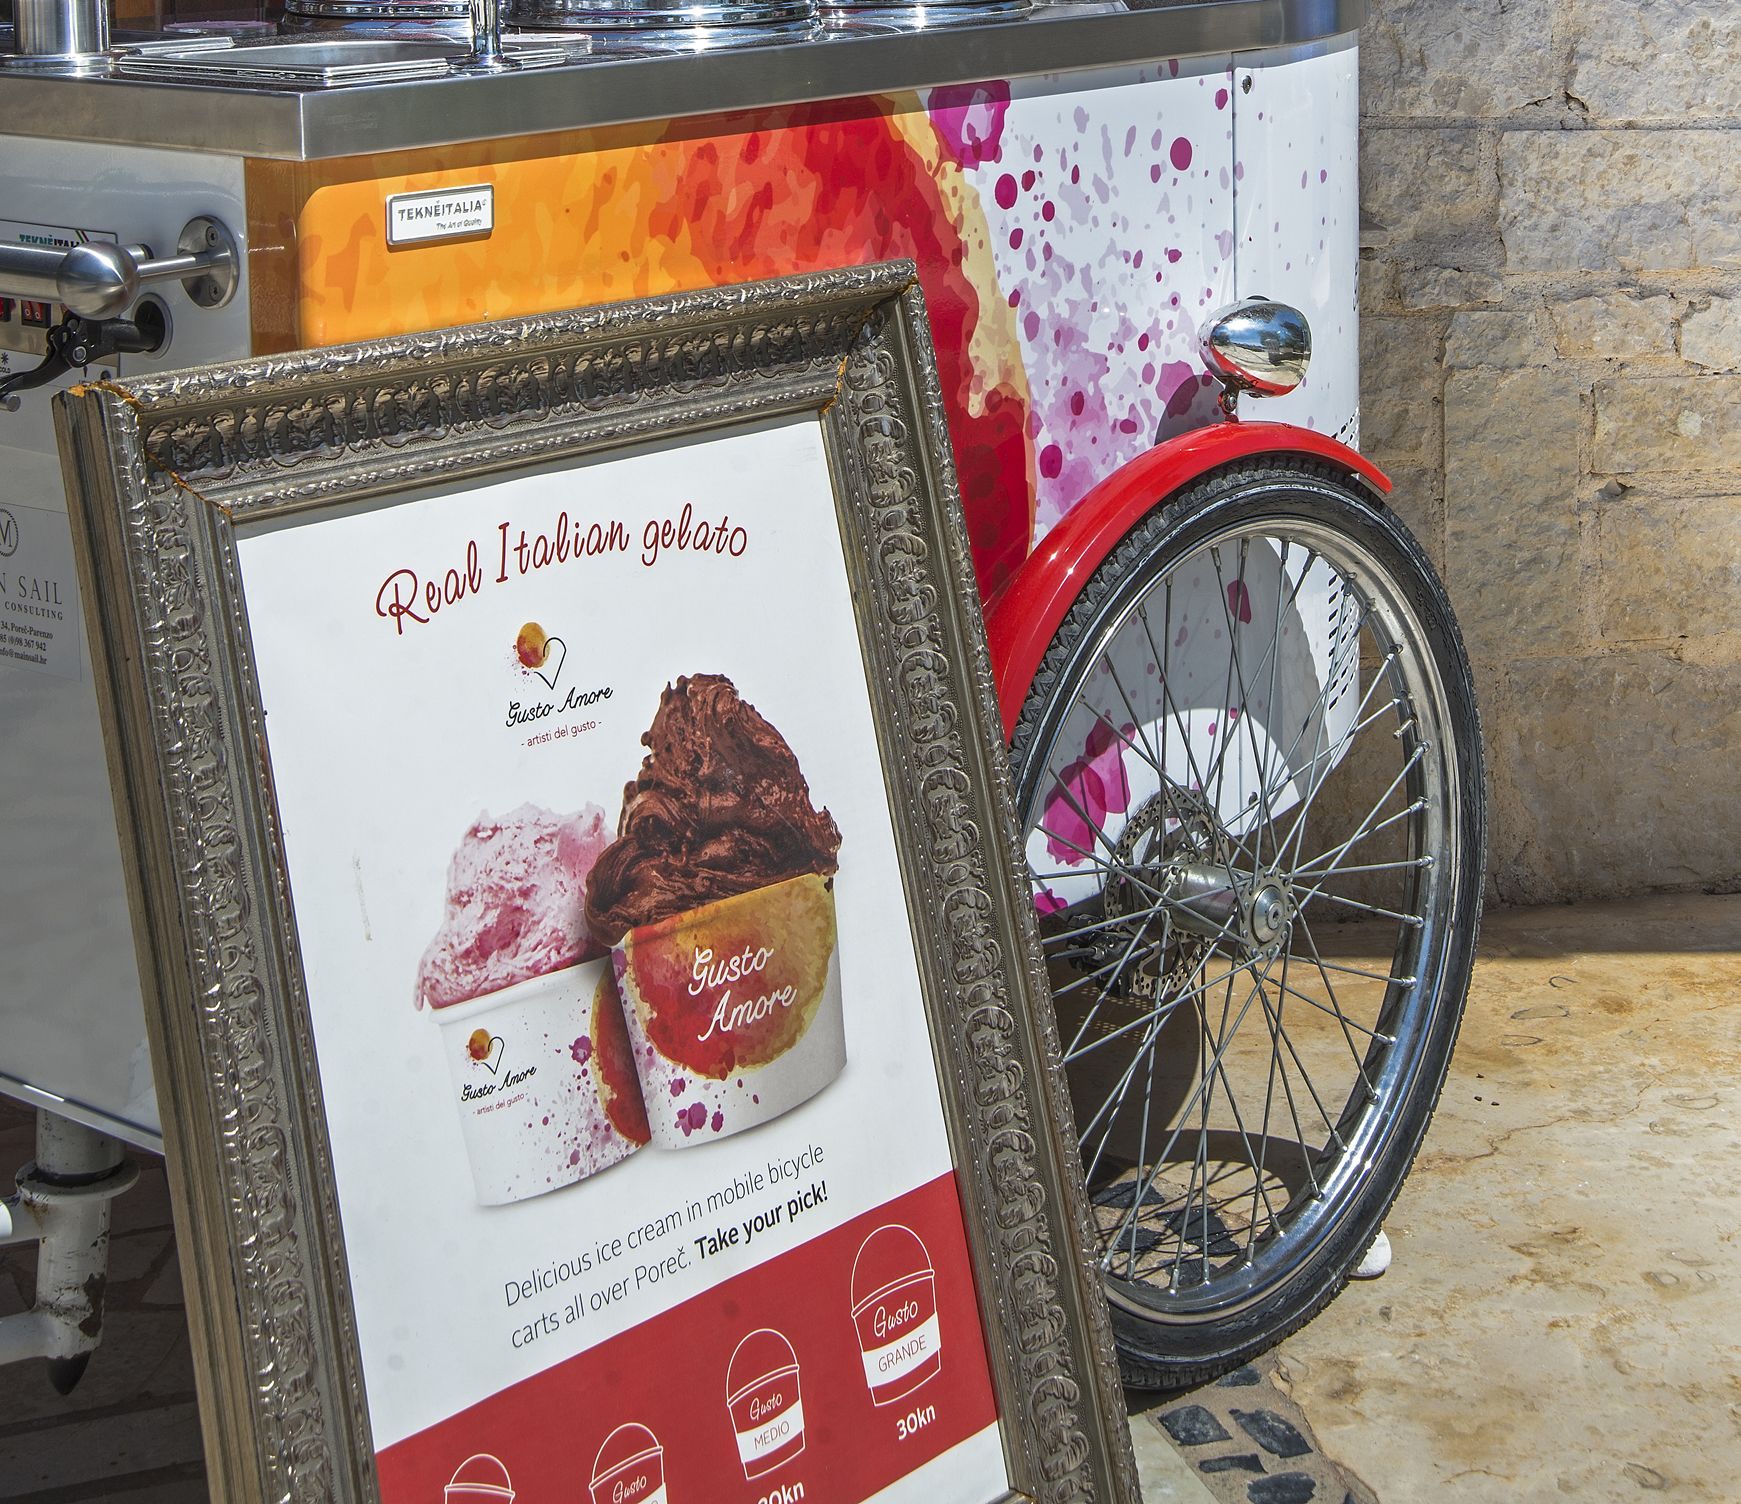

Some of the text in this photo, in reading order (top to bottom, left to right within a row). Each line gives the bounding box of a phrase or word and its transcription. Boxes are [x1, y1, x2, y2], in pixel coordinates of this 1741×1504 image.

[375, 503, 748, 635] Real Italian gelato
[18, 576, 62, 605] SAIL
[4, 601, 63, 621] CONSULTING
[506, 686, 614, 727] Gusto Amore
[527, 720, 597, 747] artisti del gusto
[688, 945, 774, 996] Gusto
[697, 985, 798, 1041] Amore
[461, 1066, 537, 1101] Gusto Amore
[476, 1093, 525, 1115] artisti del gusto
[504, 1144, 824, 1307] Delicious ice cream in mobile bicycle
[511, 1180, 829, 1348] carts all over Poreč. Take your pick!
[873, 1300, 918, 1338] Gusto
[878, 1334, 927, 1372] GRANDE
[750, 1393, 783, 1421] Gusto
[896, 1405, 936, 1441] 30kn
[754, 1420, 790, 1450] MEDIO
[613, 1476, 647, 1503] Gusto
